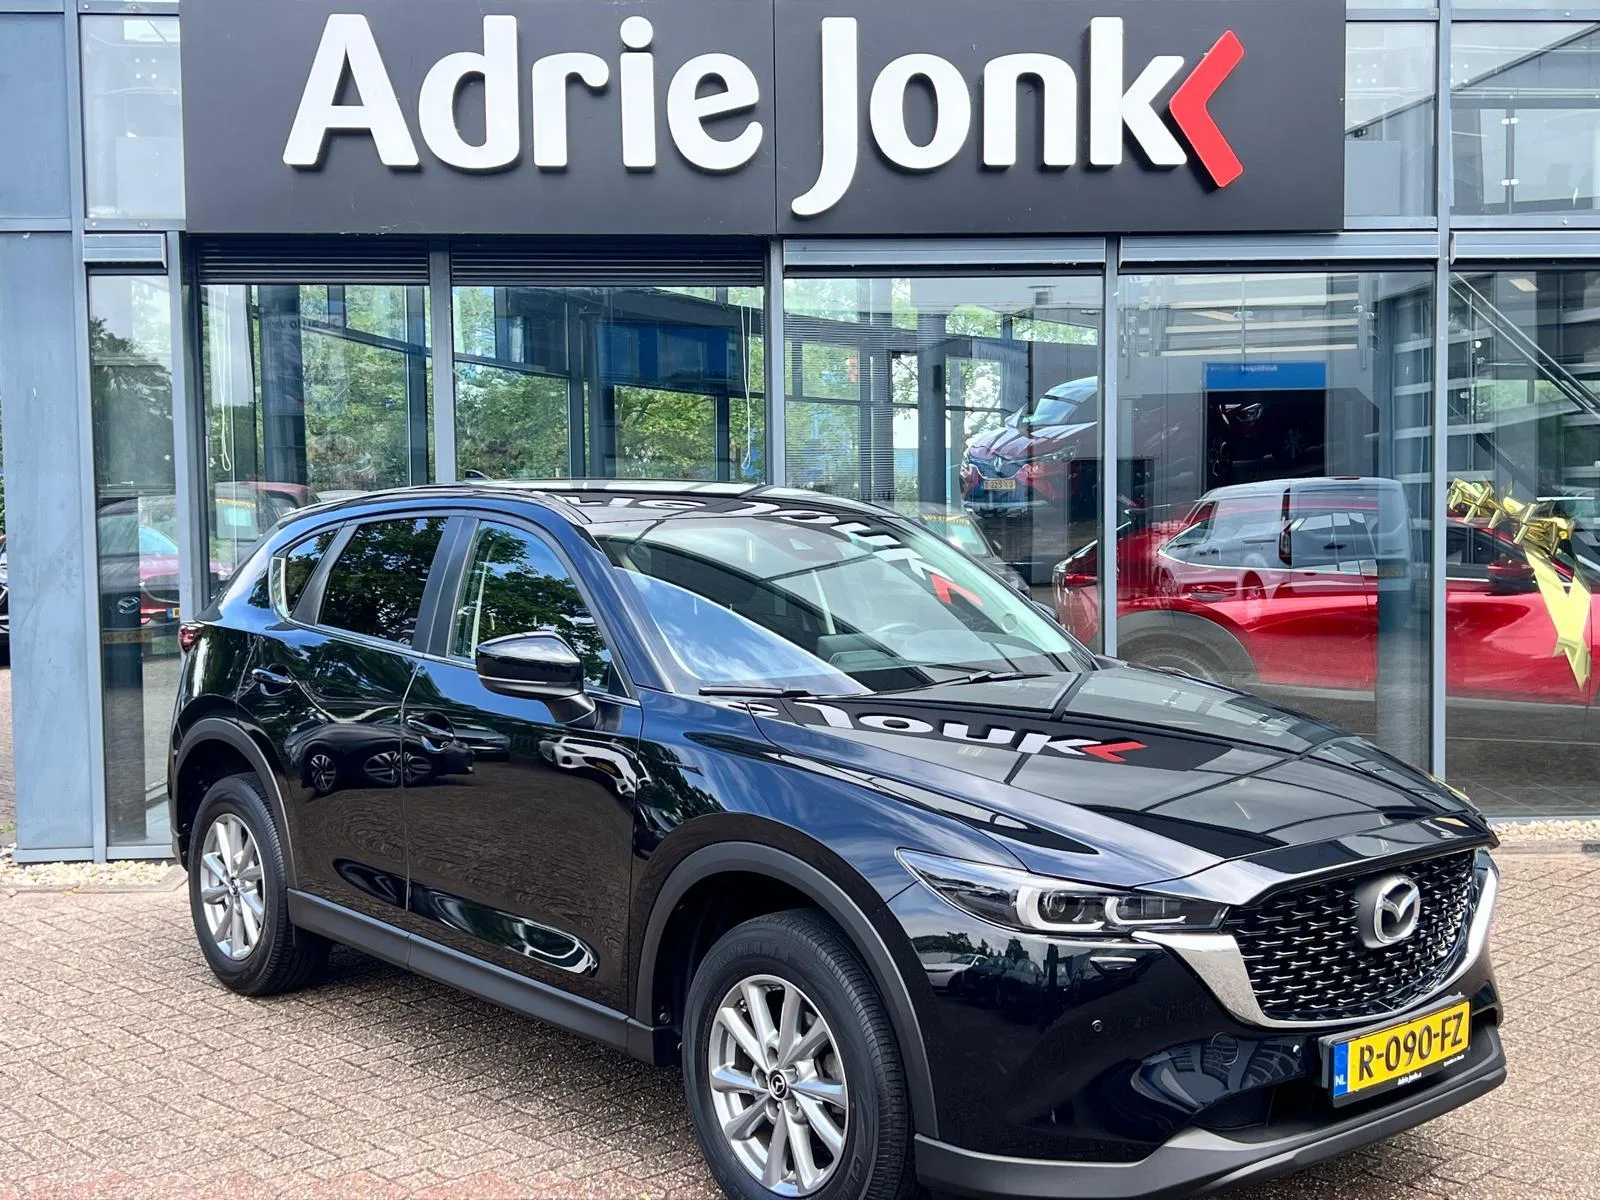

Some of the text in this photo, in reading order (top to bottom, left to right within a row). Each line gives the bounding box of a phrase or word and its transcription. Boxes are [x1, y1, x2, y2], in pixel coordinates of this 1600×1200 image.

[283, 13, 1188, 217] Adrie Jonk
[1335, 1074, 1347, 1087] NL
[1359, 1012, 1463, 1081] R-090-FZ
